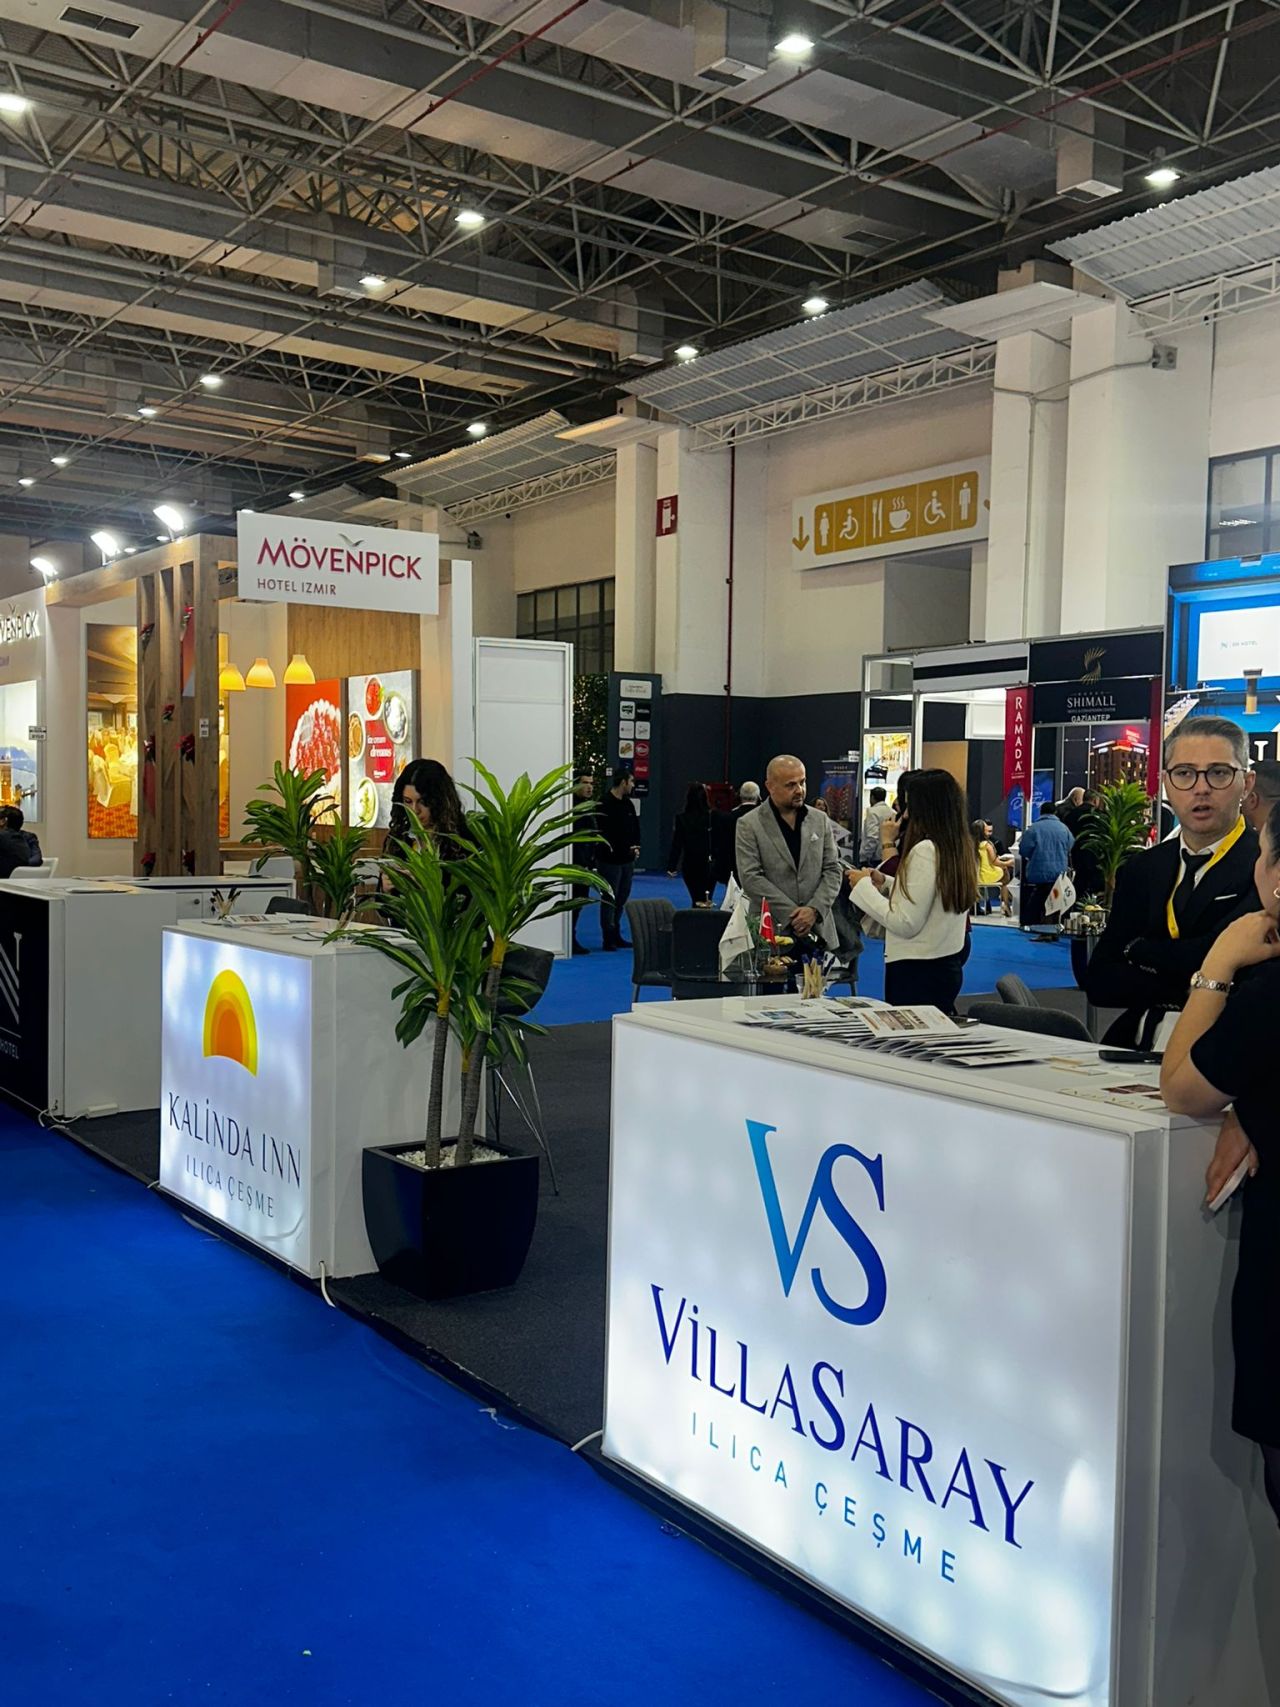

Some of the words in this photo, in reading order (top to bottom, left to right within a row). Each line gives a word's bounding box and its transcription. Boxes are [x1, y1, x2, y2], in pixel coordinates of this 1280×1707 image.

[257, 536, 422, 581] MÖVENPICK
[257, 578, 297, 593] HOTEL
[301, 582, 337, 596] IZMIR
[1014, 696, 1024, 771] RAMADA
[1066, 695, 1116, 709] SHIMALL
[168, 1091, 255, 1168] KALİNDA
[262, 1132, 301, 1190] INN
[186, 1154, 223, 1191] ILICA
[227, 1175, 275, 1219] ÇEŞME
[745, 1118, 887, 1326] VS
[691, 1411, 788, 1489] ILICA
[814, 1481, 957, 1584] ÇEŞME
